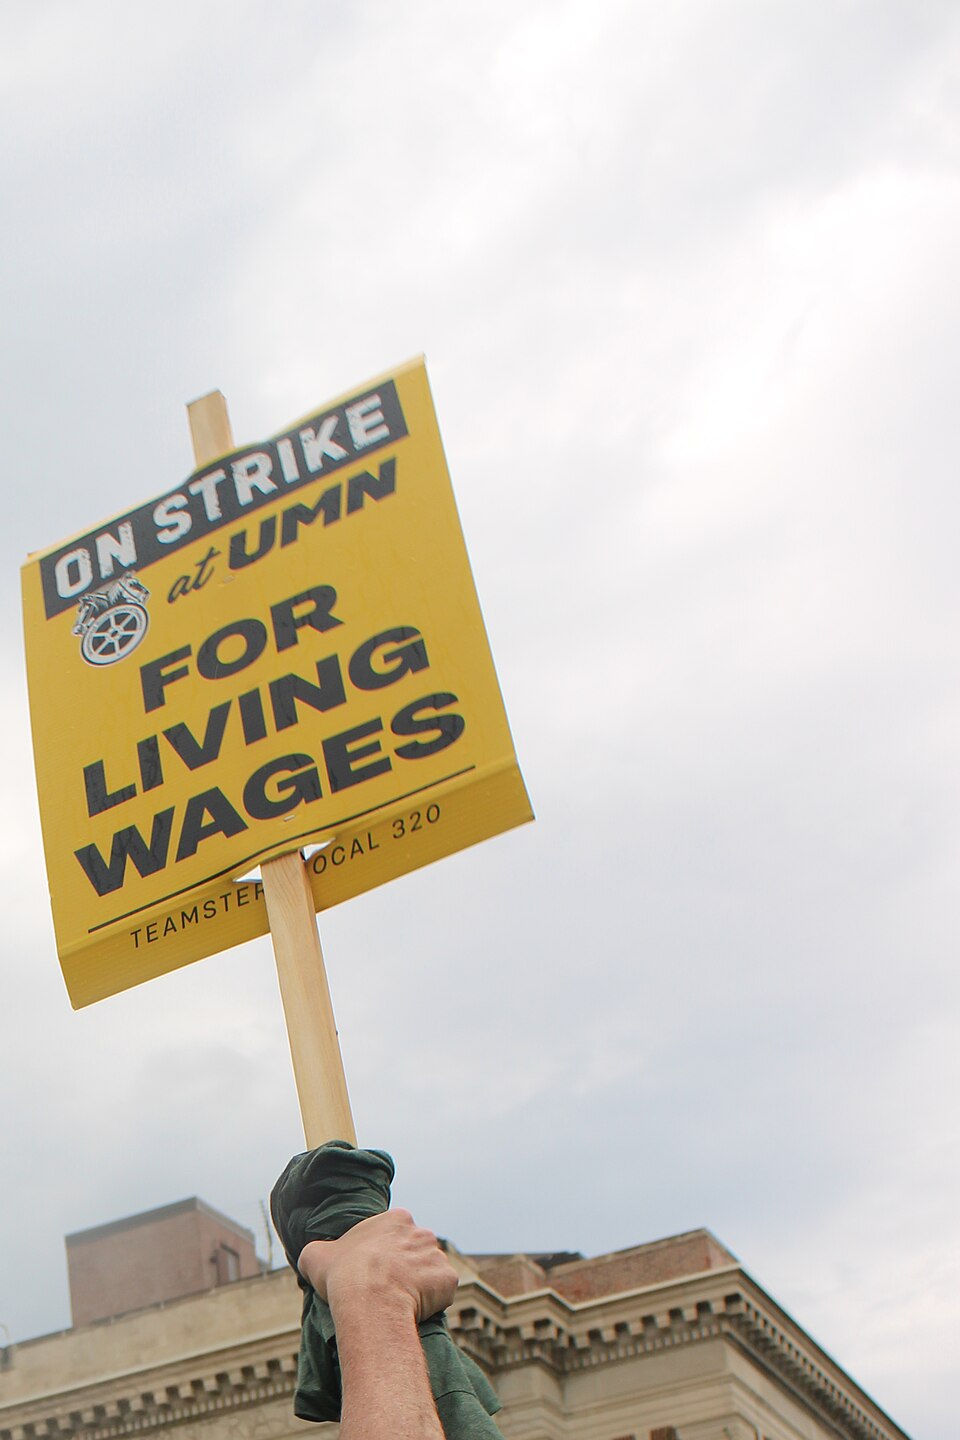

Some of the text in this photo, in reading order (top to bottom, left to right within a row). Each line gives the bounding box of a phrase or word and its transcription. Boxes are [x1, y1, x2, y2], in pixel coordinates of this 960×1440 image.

[54, 393, 391, 599] ON STRIKE
[166, 457, 397, 604] at UMN
[83, 625, 430, 818] LIVING
[139, 584, 345, 714] FOR
[73, 692, 466, 897] WAGES
[130, 804, 440, 948] TEAMSTER OCAL 320
